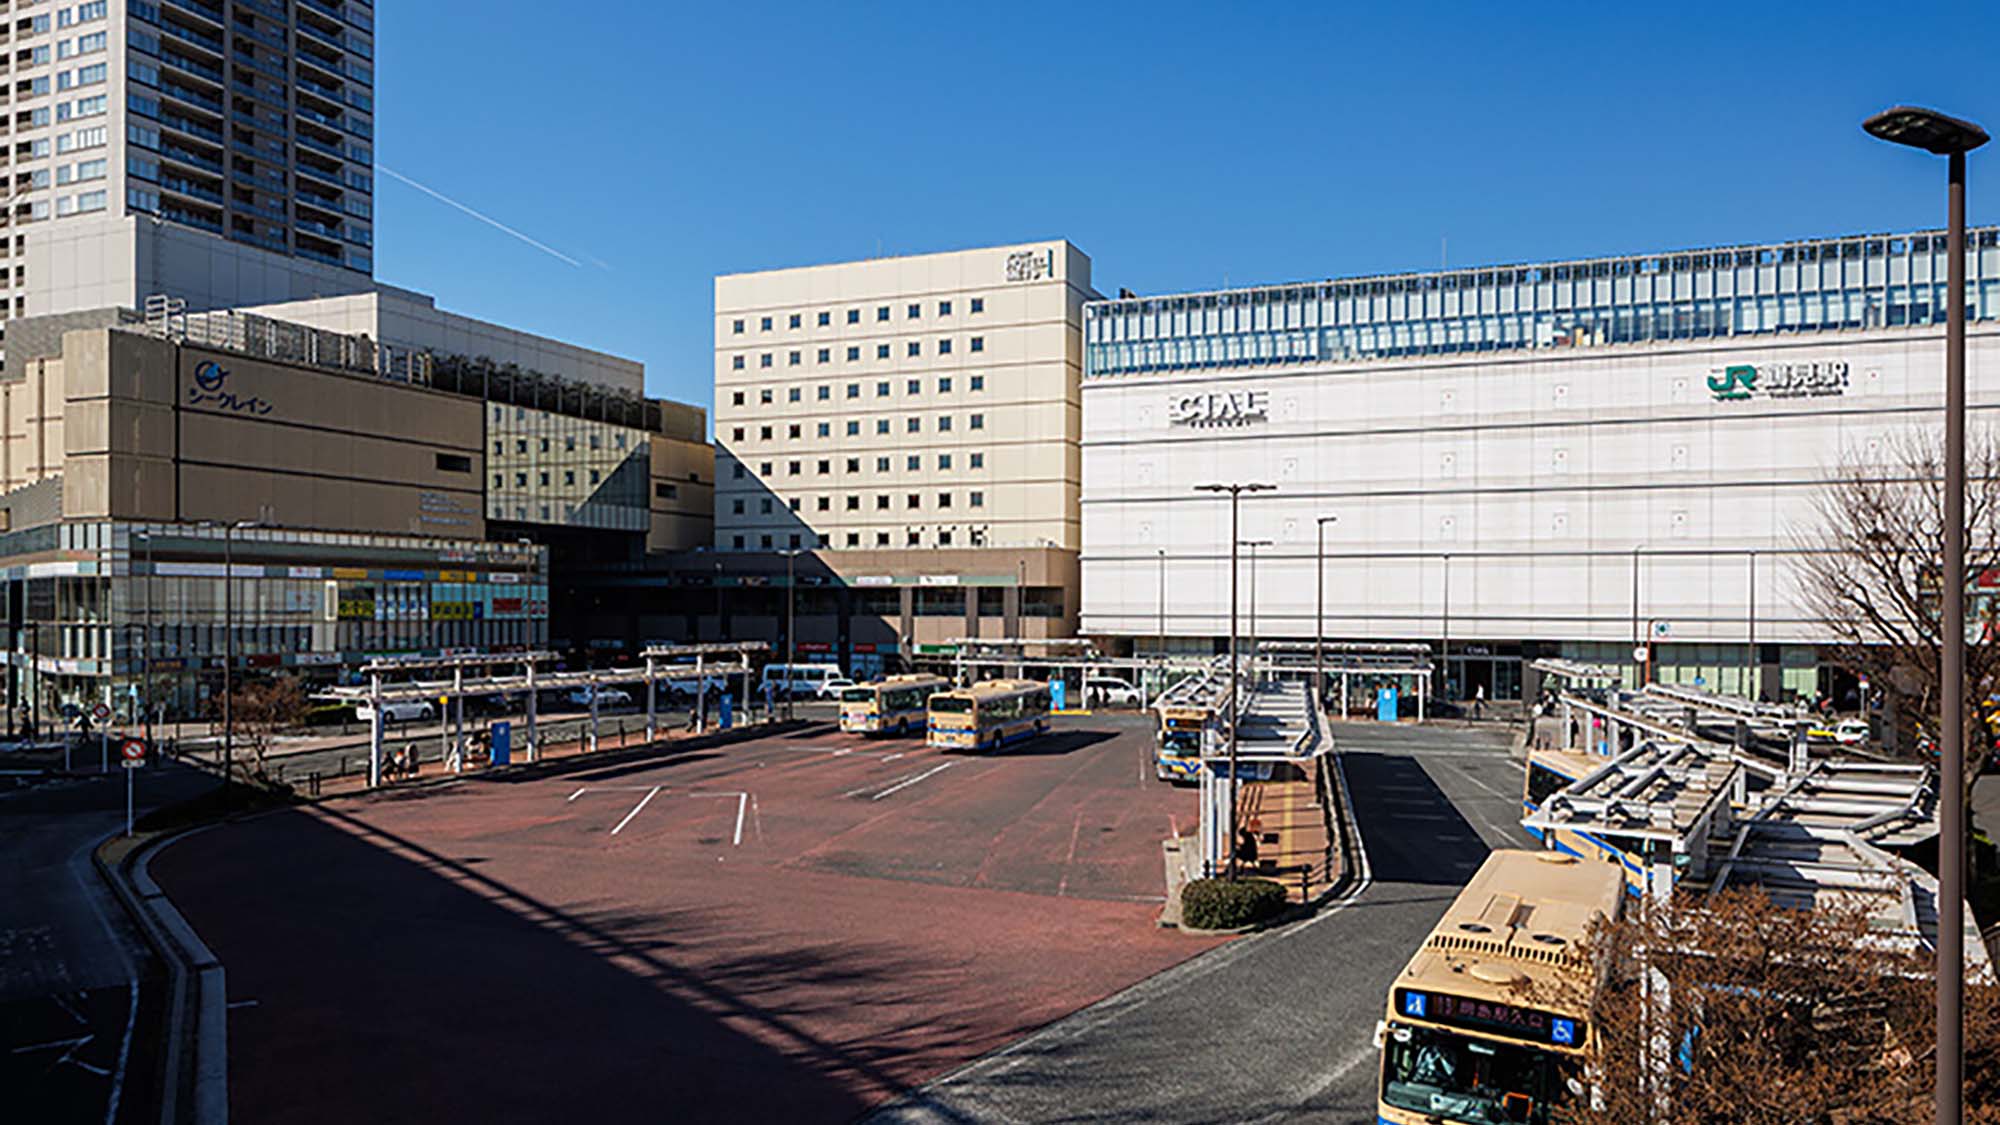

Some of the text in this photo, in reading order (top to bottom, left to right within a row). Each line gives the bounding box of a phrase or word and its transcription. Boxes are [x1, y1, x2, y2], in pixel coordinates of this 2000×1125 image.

[1707, 364, 1757, 392] JR
[190, 388, 273, 414] シークレイン
[1177, 391, 1268, 420] CIAL
